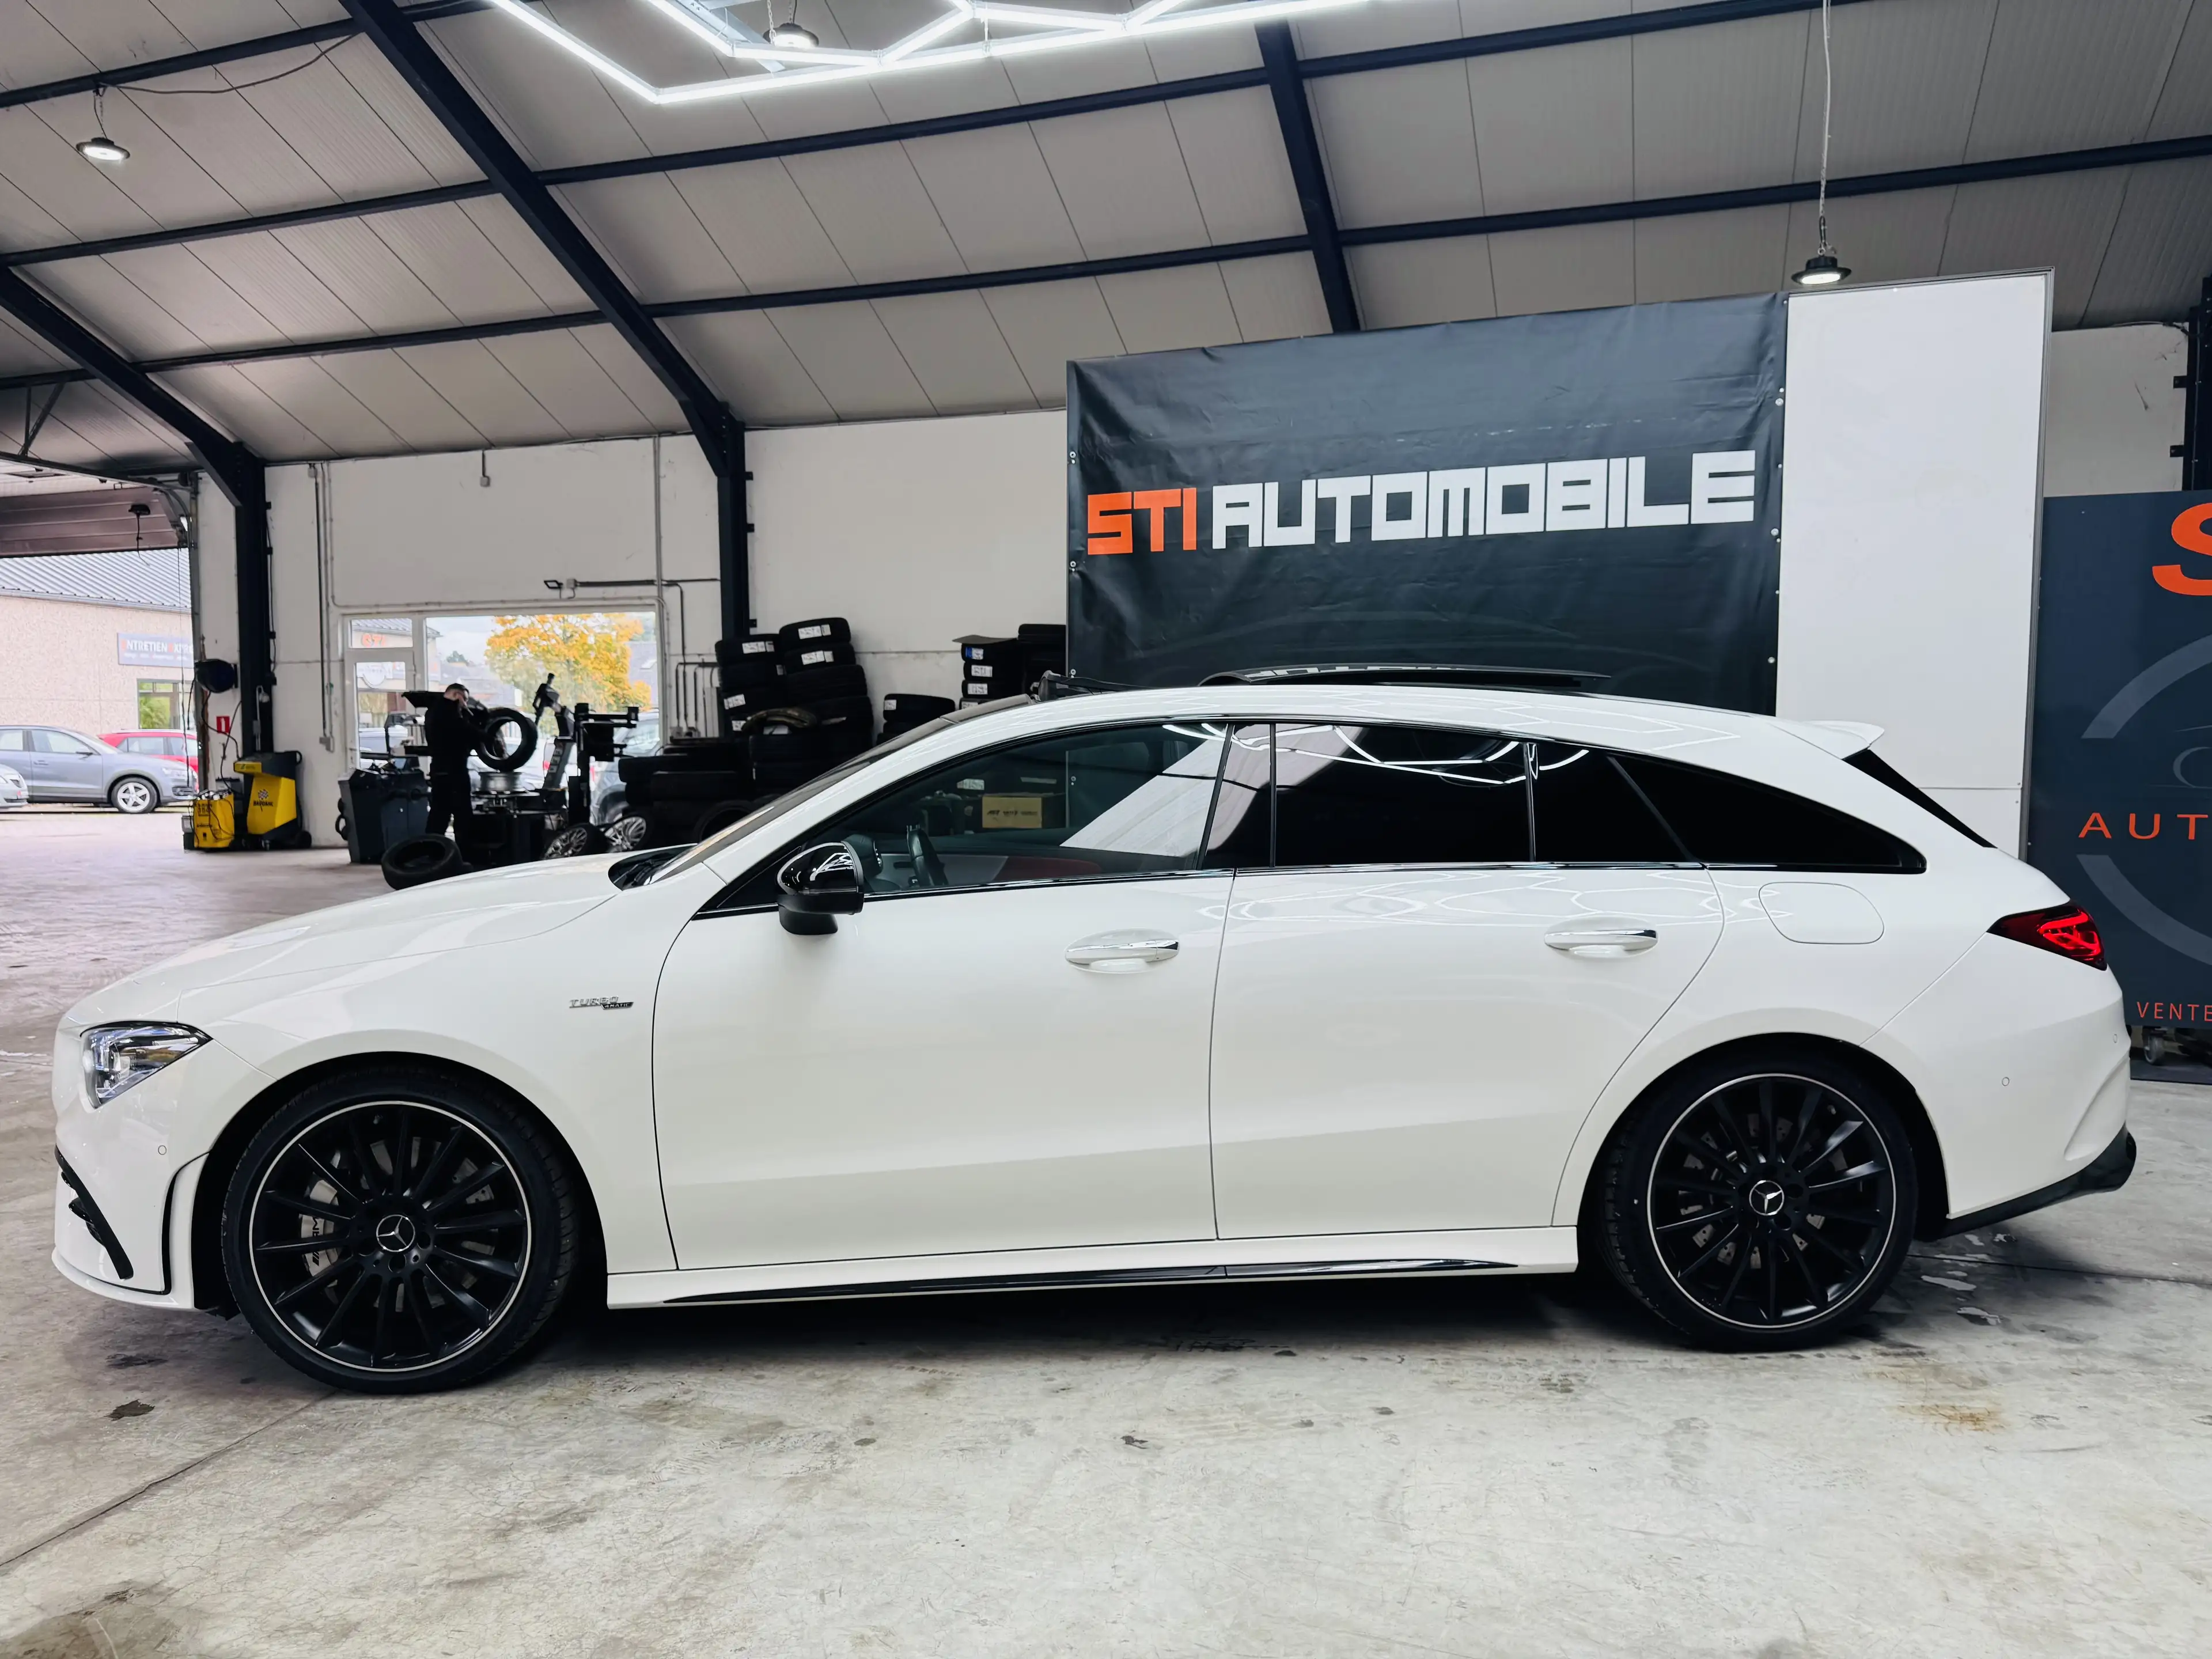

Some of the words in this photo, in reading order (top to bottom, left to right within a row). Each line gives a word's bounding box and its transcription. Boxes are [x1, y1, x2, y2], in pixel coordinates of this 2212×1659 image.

[1088, 488, 1196, 554] STI
[1211, 449, 1756, 550] AUTOMOBILE
[2078, 812, 2209, 840] AUT
[569, 995, 619, 1007] TURBO
[2136, 1001, 2212, 1022] VENTE
